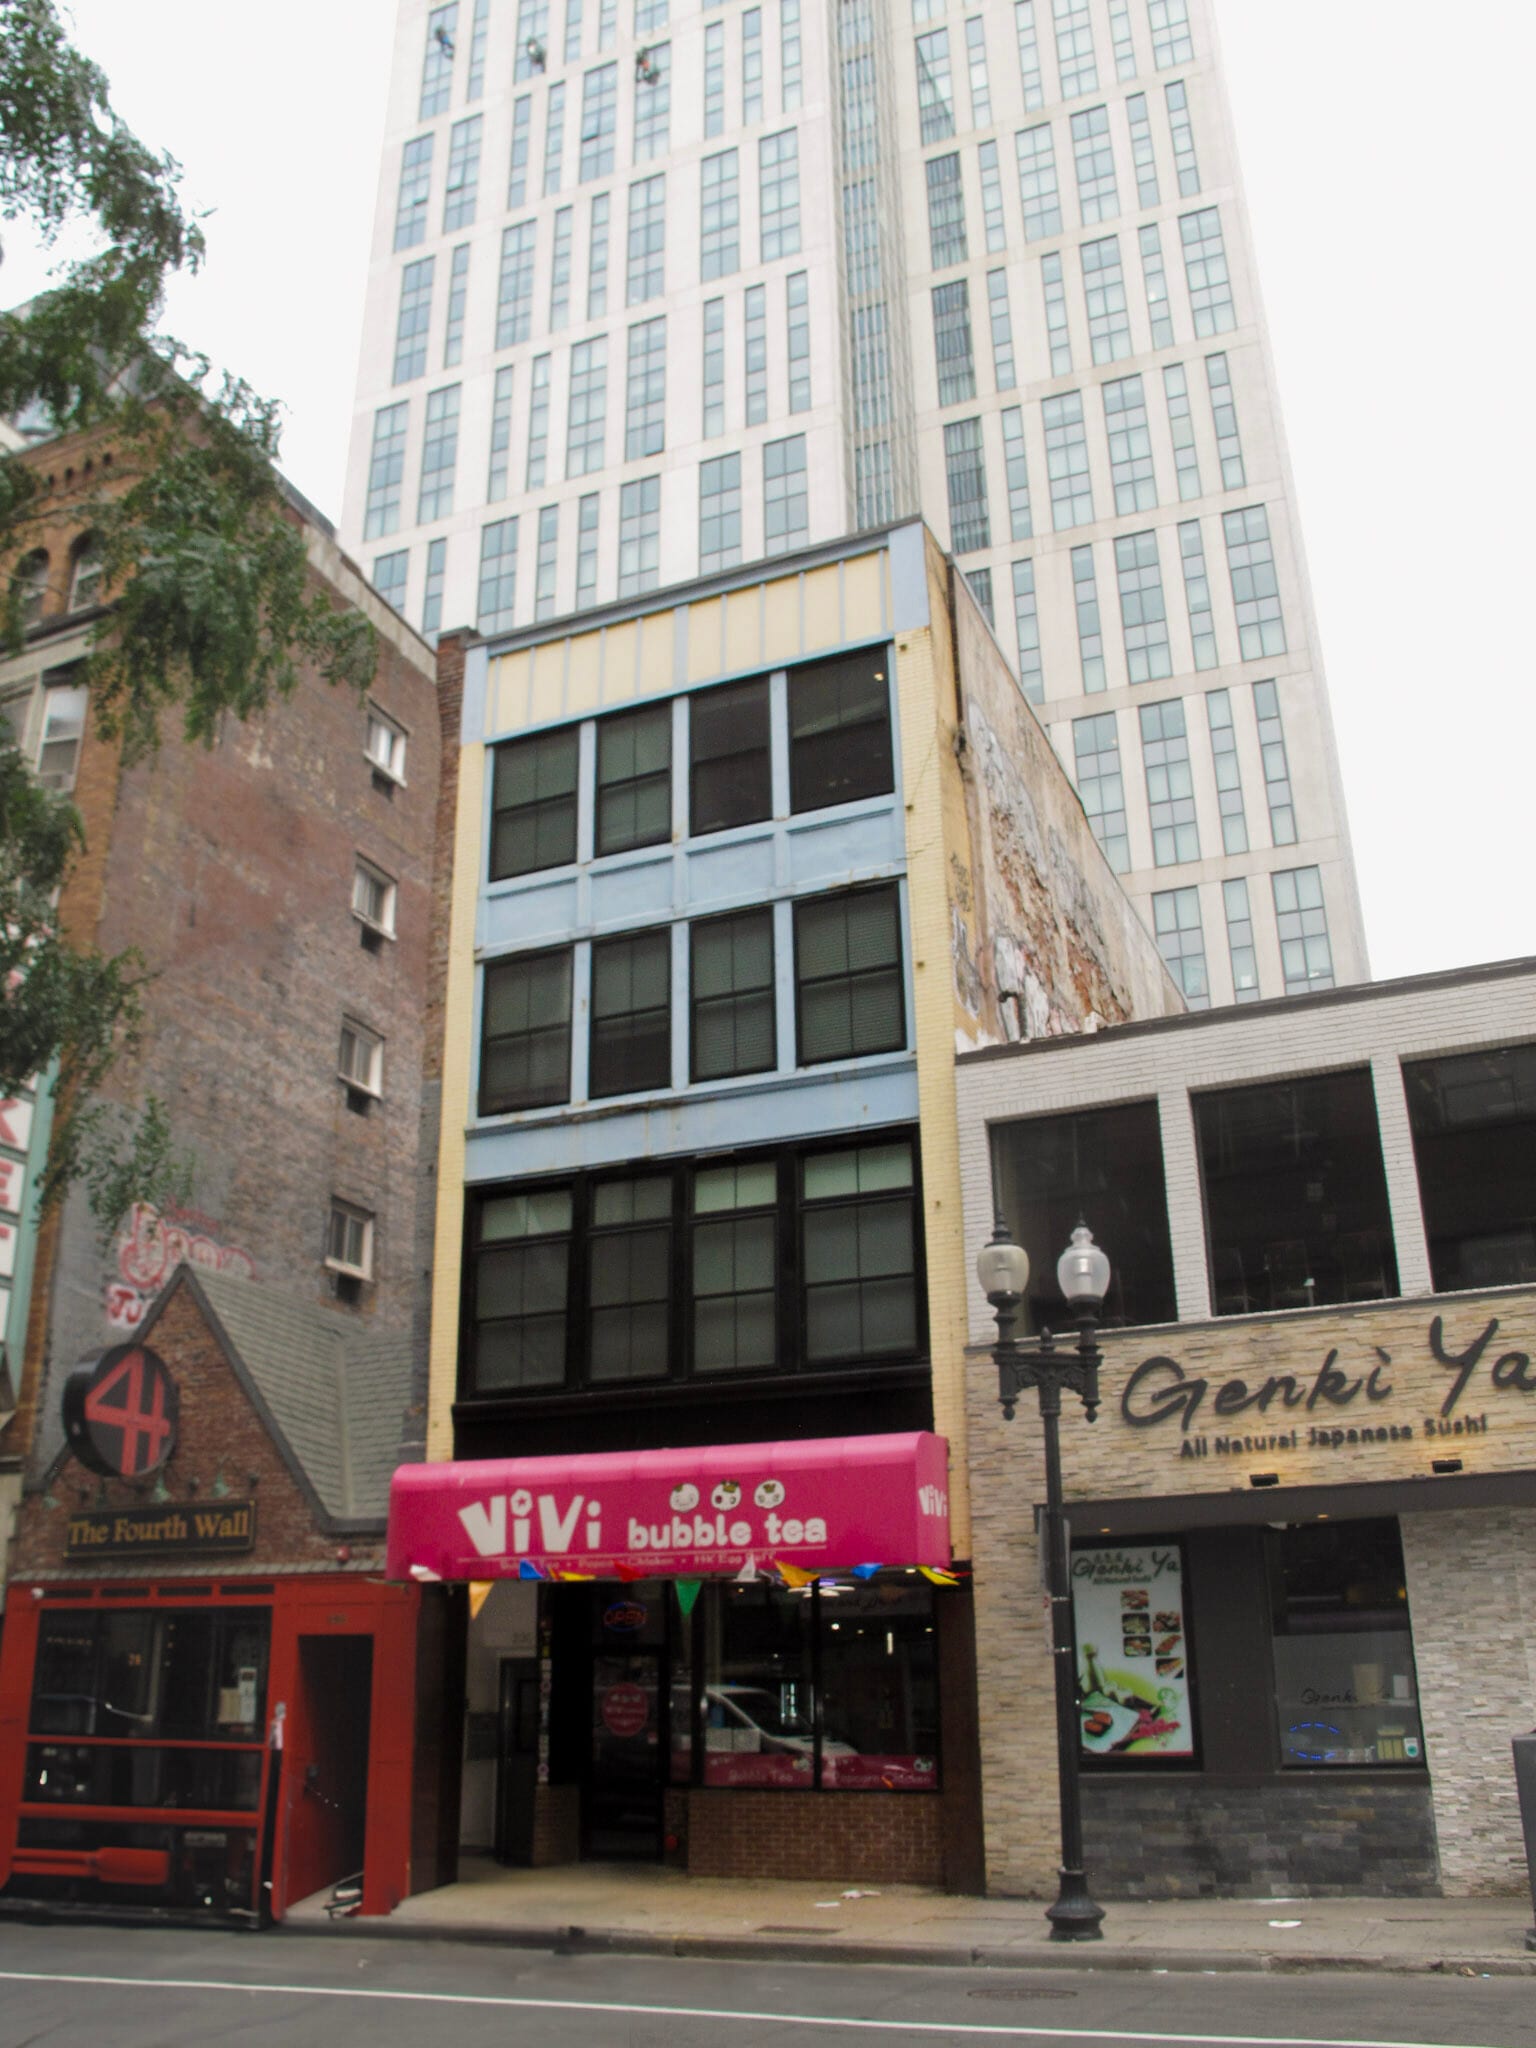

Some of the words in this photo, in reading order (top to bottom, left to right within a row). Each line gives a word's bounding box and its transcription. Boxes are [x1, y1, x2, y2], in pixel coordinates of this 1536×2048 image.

[1120, 1346, 1394, 1432] Genki
[1180, 1437, 1208, 1459] All
[1215, 1429, 1298, 1456] Natural
[1307, 1424, 1414, 1450] Japanese
[1423, 1413, 1488, 1438] Sushi
[68, 1521, 109, 1546] The
[113, 1513, 188, 1543] Fourth
[194, 1509, 249, 1538] Wall
[457, 1488, 603, 1557] ViVi
[628, 1513, 752, 1550] bubble
[764, 1512, 828, 1545] tea
